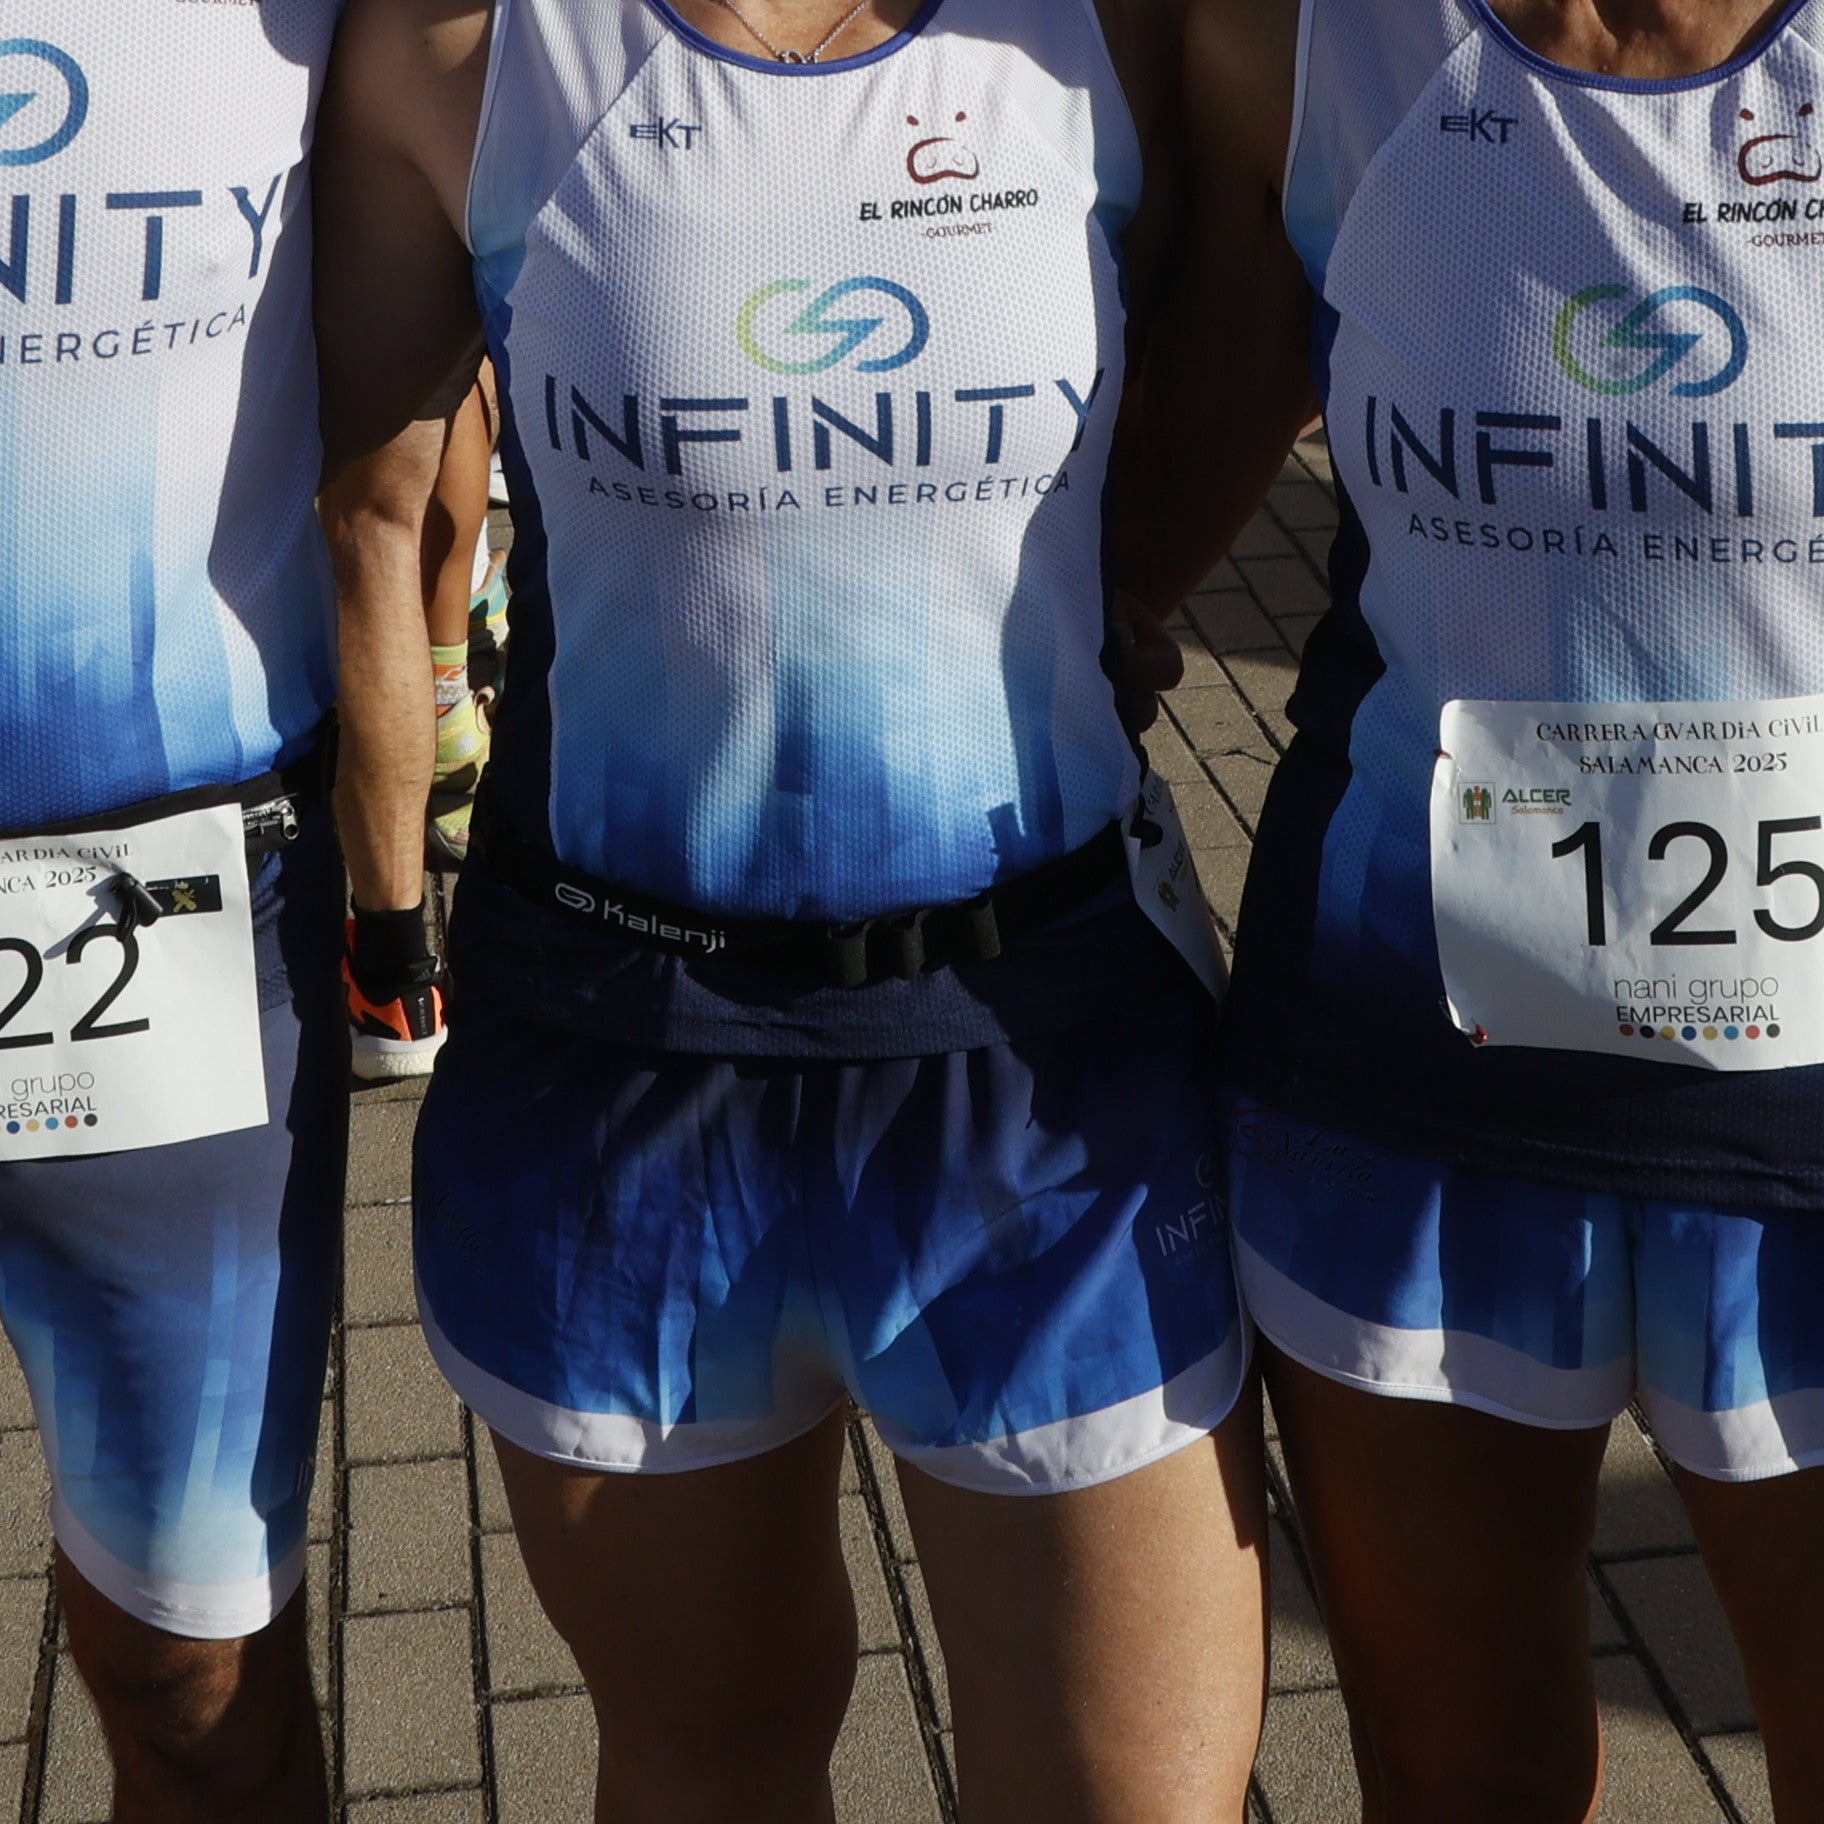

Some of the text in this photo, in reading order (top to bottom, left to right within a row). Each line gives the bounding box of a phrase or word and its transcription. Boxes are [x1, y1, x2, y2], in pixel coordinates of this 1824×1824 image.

[859, 188, 1039, 222] EL RINCÓN CHARRO
[1682, 201, 1709, 225] EL
[1717, 195, 1797, 225] RINCÓN
[545, 367, 1106, 476] INFINITY
[588, 472, 1070, 512] ASESORÍA ENERGÉTICA
[1408, 512, 1618, 558] ASESORÍA
[1535, 721, 1646, 744] CARRERA
[1578, 751, 1789, 775] SALAMANCA 2025
[1501, 786, 1572, 807] ALCER
[1511, 806, 1564, 815] Salamanca
[44, 865, 97, 890] 2025
[603, 900, 727, 954] Kalenji
[1613, 973, 1780, 1006] nani grupo
[1616, 1004, 1780, 1023] EMPRESARIAL
[10, 1069, 96, 1100] grupo
